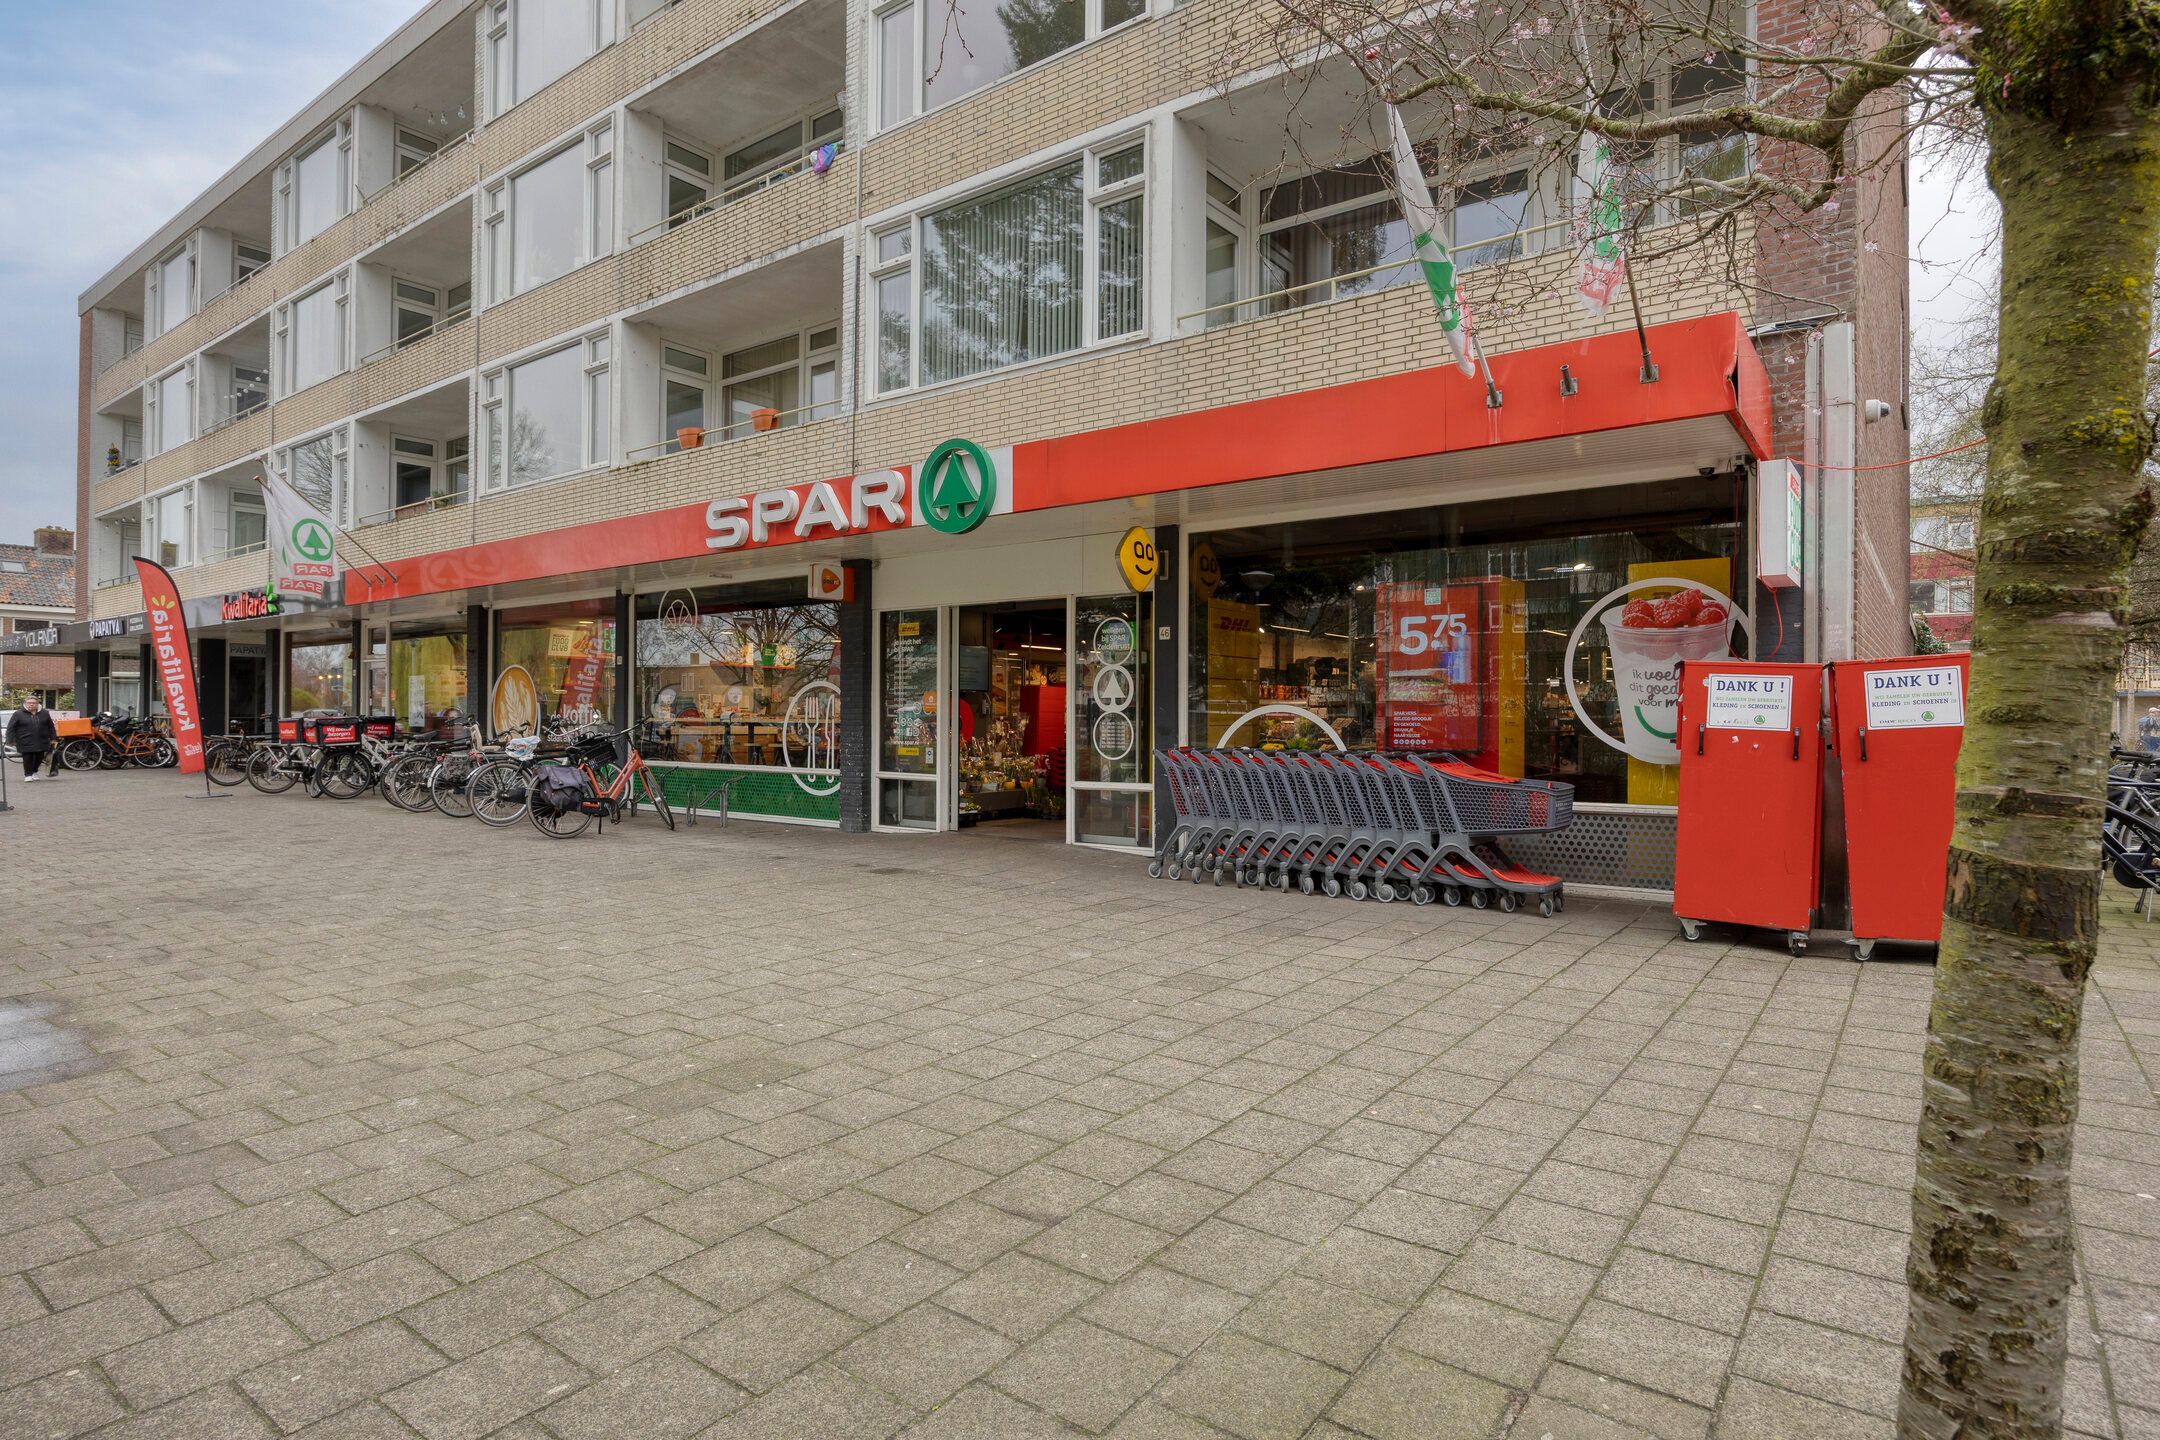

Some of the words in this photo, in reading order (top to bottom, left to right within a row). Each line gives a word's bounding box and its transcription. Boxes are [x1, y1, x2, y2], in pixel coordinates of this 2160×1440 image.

[705, 470, 906, 549] SPAR
[221, 591, 268, 620] kwalitaria
[95, 619, 121, 637] PAPATYA
[1219, 616, 1250, 632] DHL
[24, 627, 58, 647] YOLANDA
[552, 636, 569, 644] FOOD
[1109, 634, 1126, 642] SPAR
[1160, 629, 1170, 638] 46
[551, 644, 568, 652] CLUB
[1632, 669, 1642, 680] ik
[1873, 675, 1922, 689] DANK
[1927, 673, 1939, 686] U
[1947, 673, 1952, 685] !
[1629, 682, 1644, 693] dit
[1646, 681, 1678, 700] goed
[1716, 680, 1758, 692] DANK
[1763, 681, 1775, 693] U
[1780, 682, 1785, 693] !
[1638, 698, 1662, 707] voor
[1912, 698, 1949, 706] SCHOENEN
